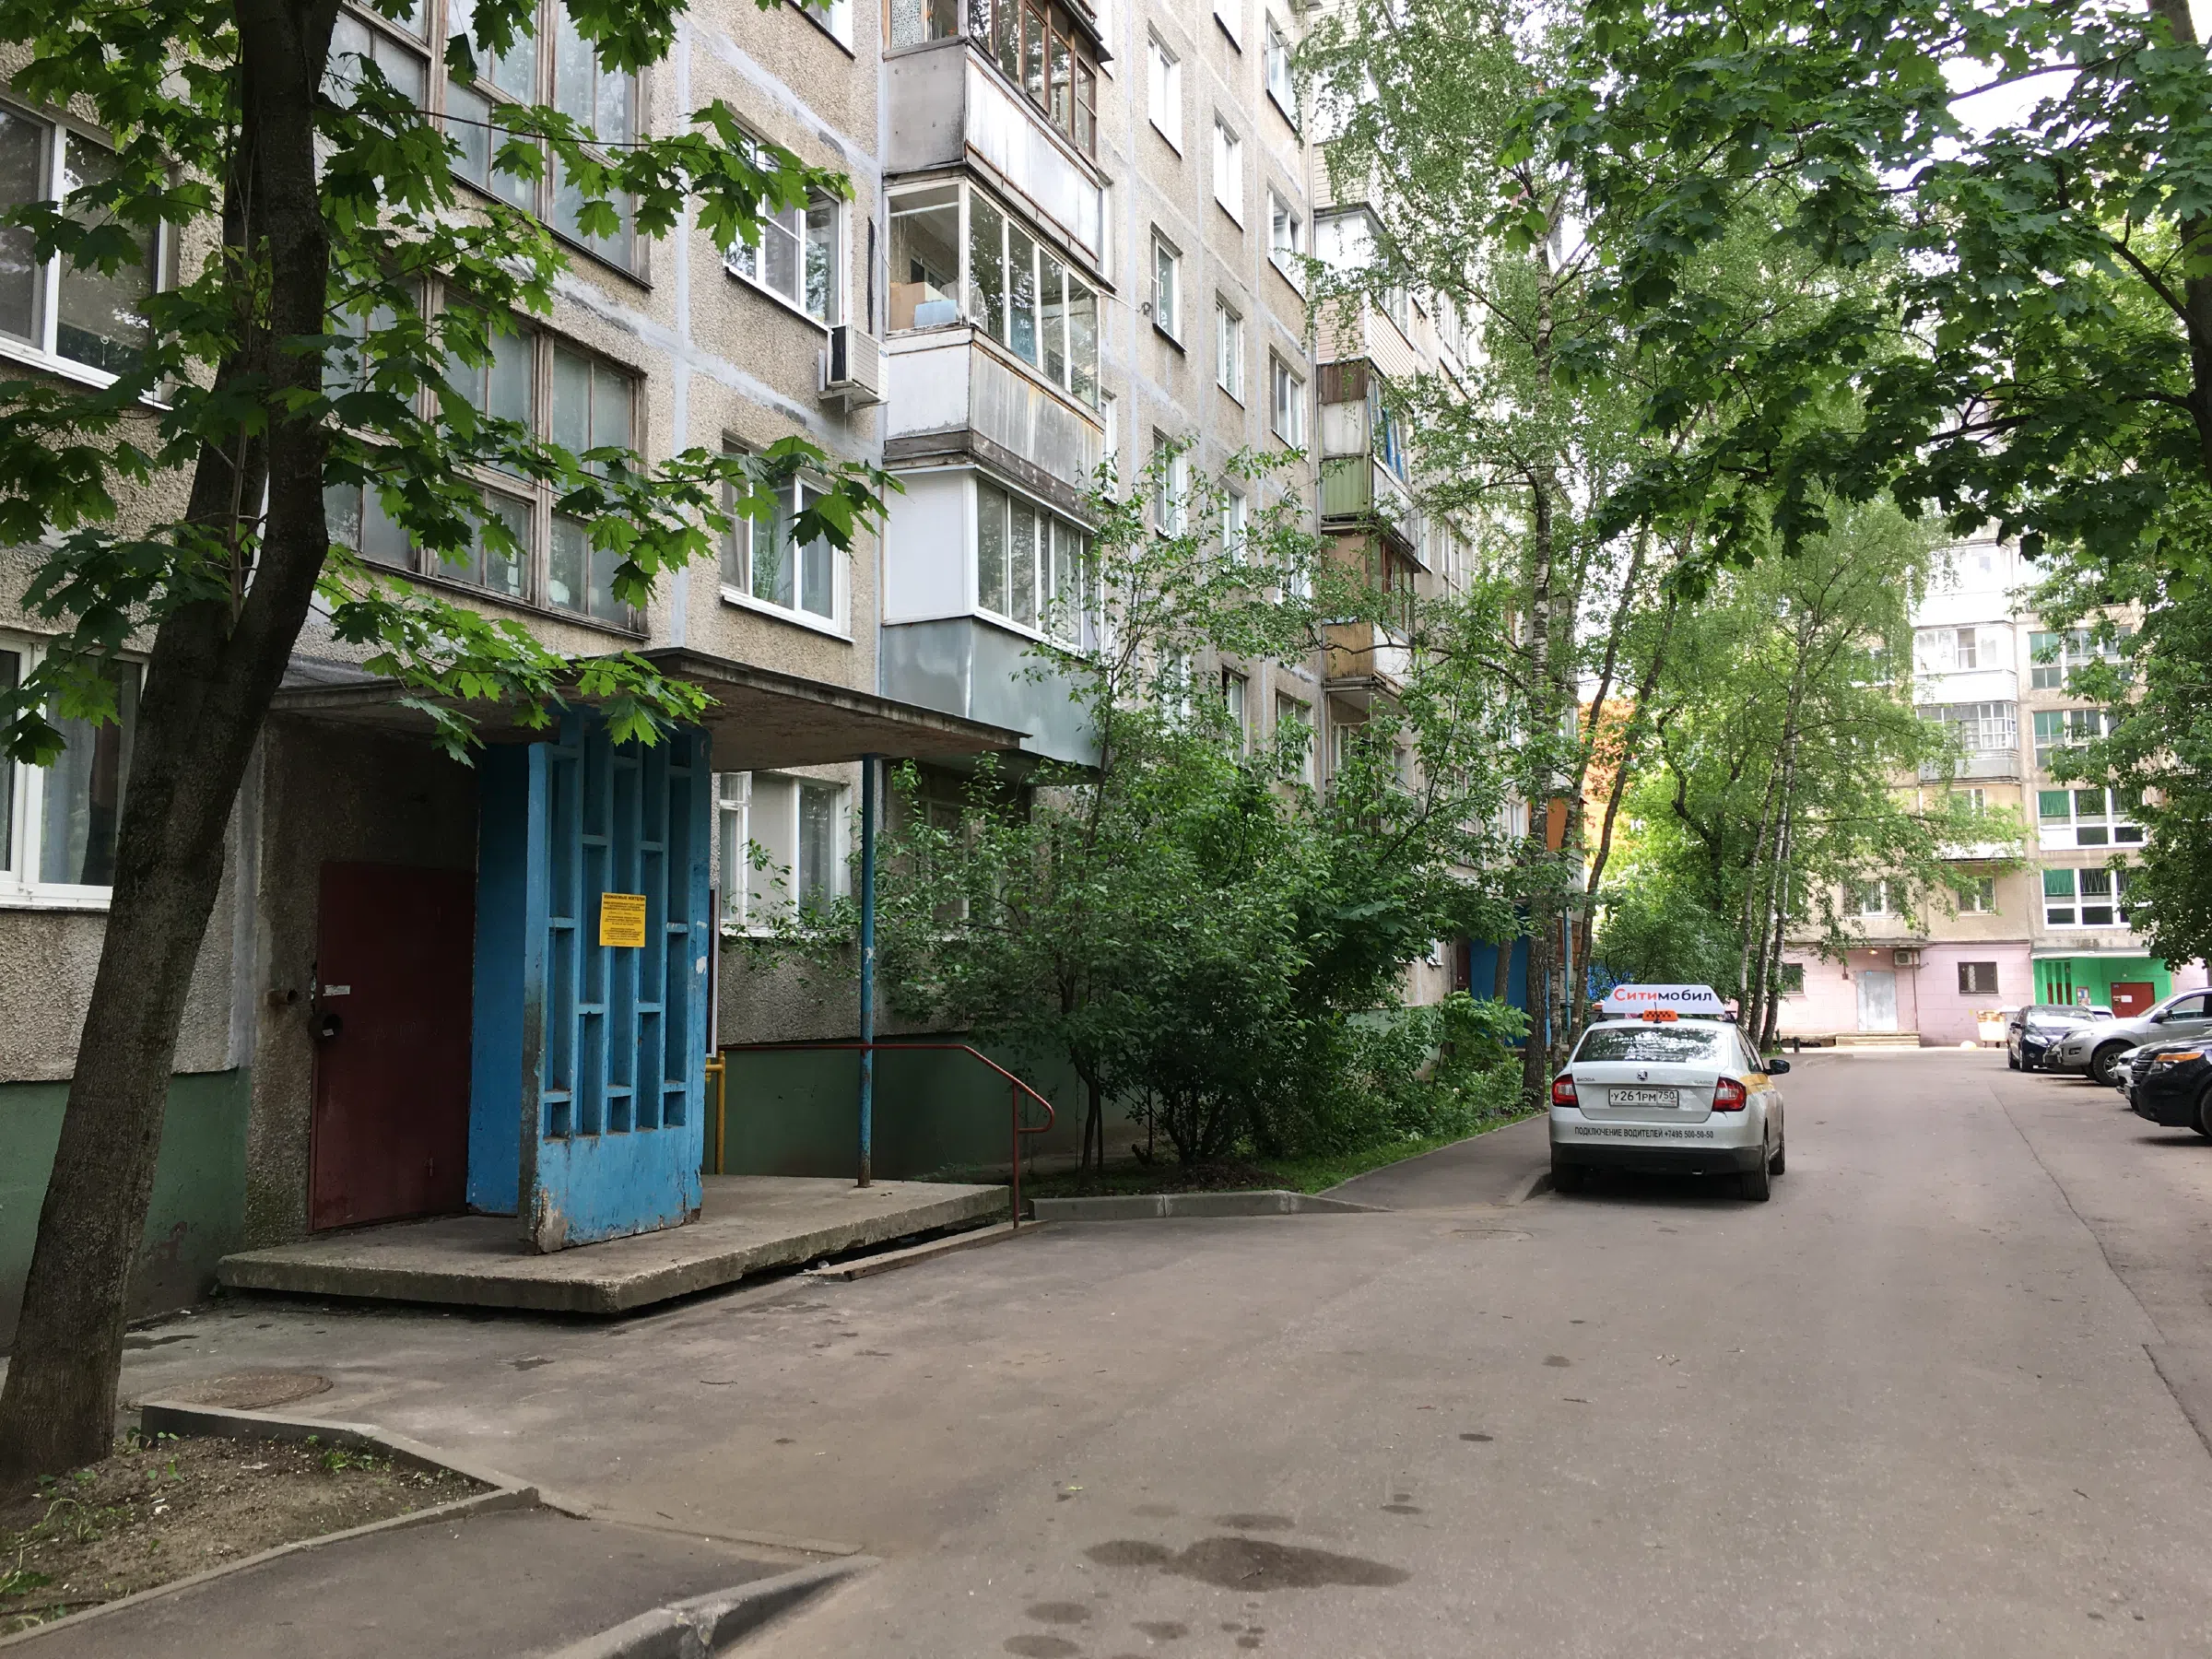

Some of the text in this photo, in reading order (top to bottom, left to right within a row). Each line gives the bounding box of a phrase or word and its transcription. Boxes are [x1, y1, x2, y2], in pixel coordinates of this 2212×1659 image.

[1614, 988, 1712, 1001] Ситимобил
[1574, 1126, 1713, 1138] ПОДКЛЮЧЕНИЕ ВОДИТЕЛЕЙ +7495 500-50-50
